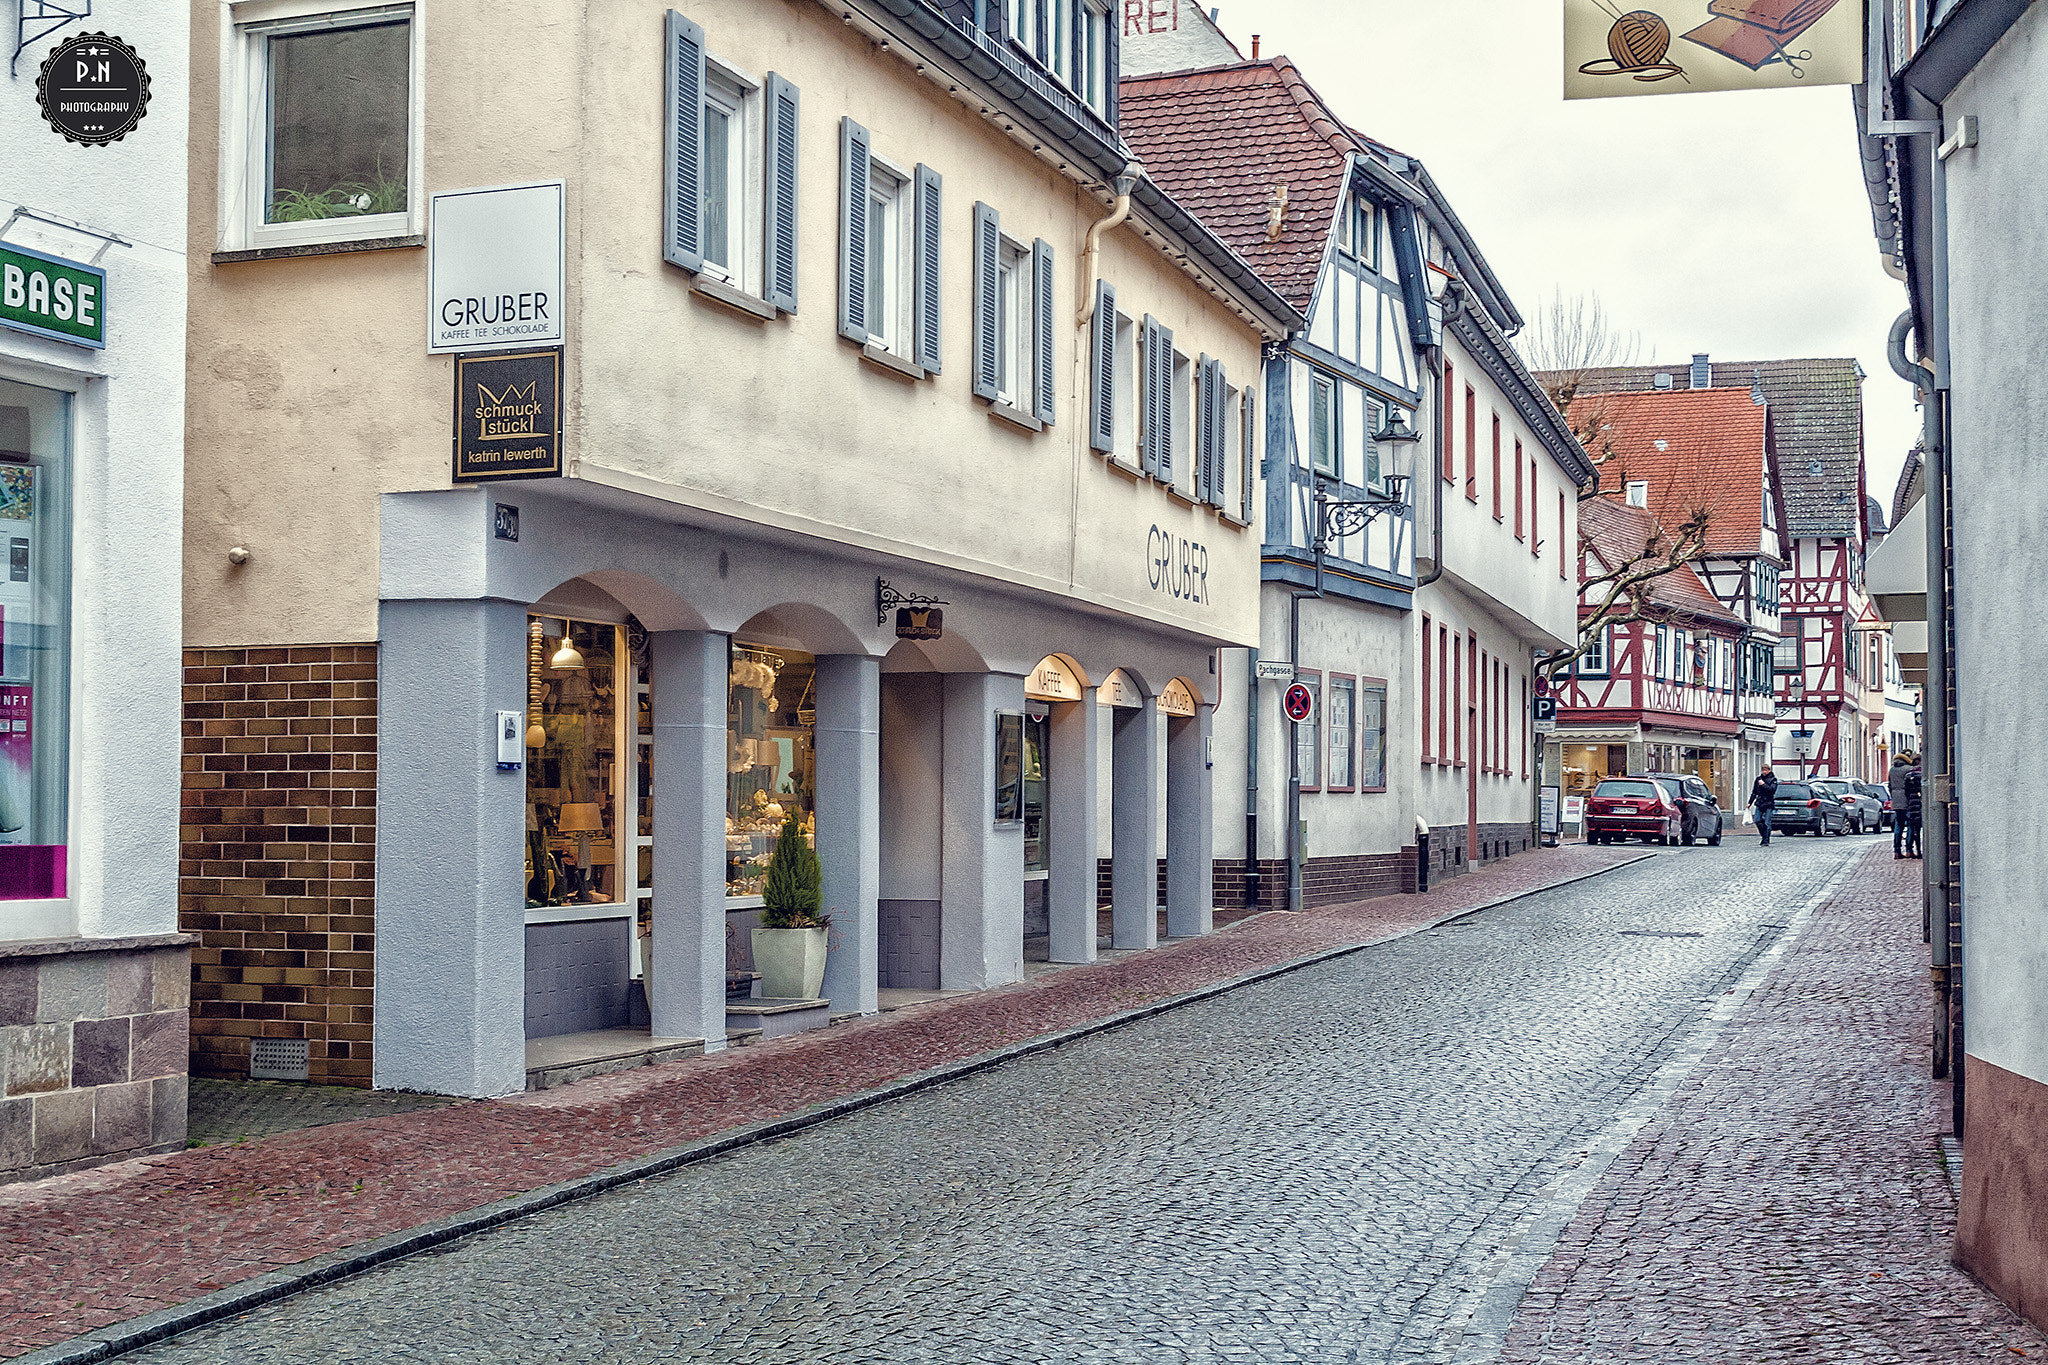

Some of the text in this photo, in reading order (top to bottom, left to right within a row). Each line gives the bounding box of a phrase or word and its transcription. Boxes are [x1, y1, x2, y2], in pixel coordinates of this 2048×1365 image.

[3, 263, 95, 327] BASE
[441, 292, 549, 327] GRUBER
[441, 323, 549, 340] KAFFEE TEE SCHOKOLADE
[475, 400, 542, 419] schmuck
[488, 417, 529, 434] stück
[468, 447, 547, 463] katrin lewerth
[1146, 523, 1209, 606] GRUBER
[1037, 669, 1062, 694] KAFFEE
[0, 695, 28, 706] NFT
[1111, 681, 1122, 702] TEE
[1538, 700, 1551, 717] P
